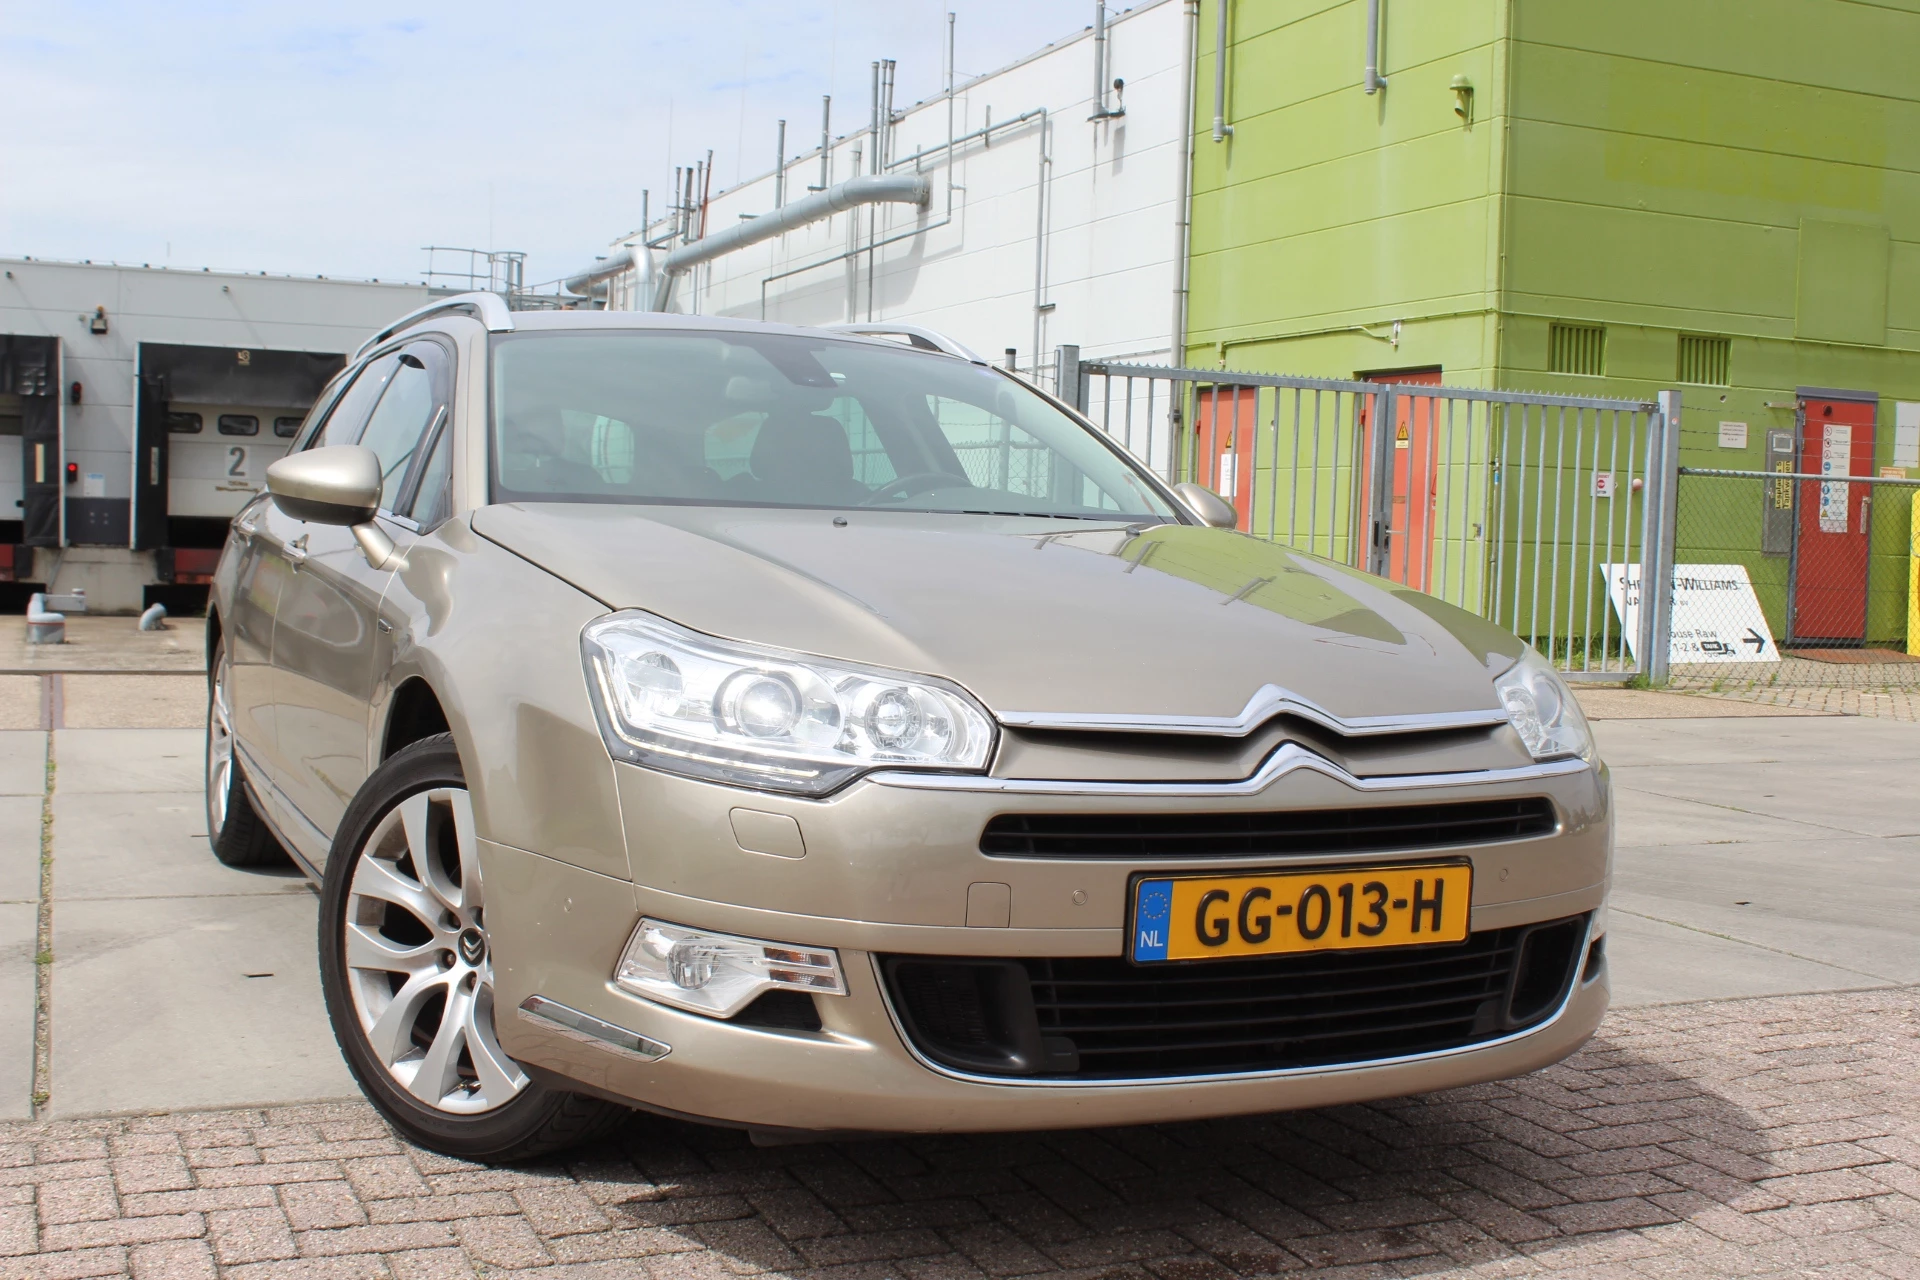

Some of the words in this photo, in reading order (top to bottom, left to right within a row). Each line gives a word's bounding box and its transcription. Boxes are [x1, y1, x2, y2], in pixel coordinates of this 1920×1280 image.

[229, 447, 245, 476] 2
[1695, 628, 1717, 638] Raw
[1195, 878, 1444, 947] GG-013-H
[1140, 930, 1163, 948] NL
